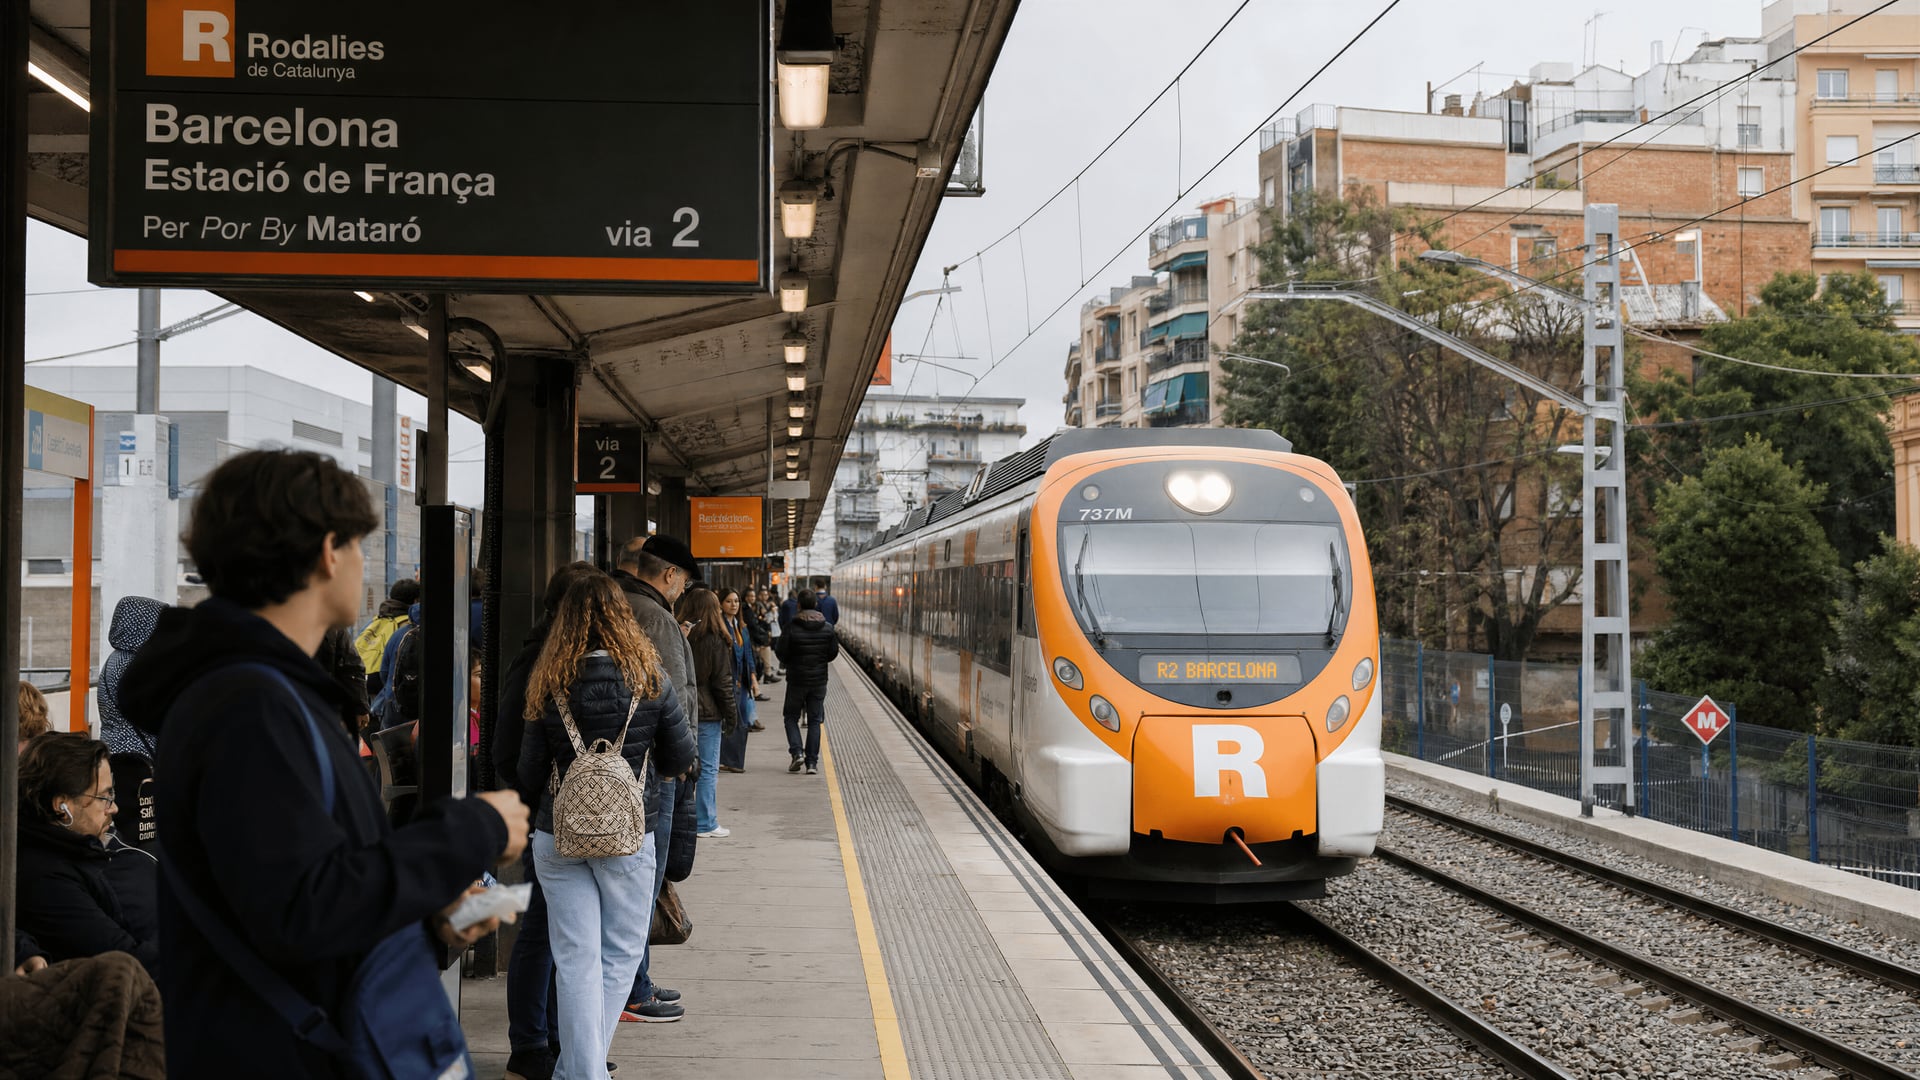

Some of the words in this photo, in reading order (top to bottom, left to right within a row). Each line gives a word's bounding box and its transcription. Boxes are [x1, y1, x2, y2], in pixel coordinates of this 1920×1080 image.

[182, 10, 231, 62] R
[248, 33, 385, 60] Rodalies
[247, 63, 268, 78] de
[273, 63, 355, 82] Catalunya
[146, 103, 398, 148] Barcelona
[146, 159, 290, 193] Estació
[303, 163, 351, 194] de
[364, 164, 495, 204] França
[143, 216, 189, 239] Per
[201, 216, 251, 240] Por
[260, 217, 296, 246] By
[307, 216, 422, 243] Mataró
[606, 220, 652, 247] via
[671, 207, 700, 247] 2
[595, 436, 620, 451] via
[599, 455, 616, 479] 2
[1079, 507, 1133, 521] 737M
[1157, 661, 1179, 679] R2
[1186, 661, 1277, 679] BARCELONA
[1697, 711, 1717, 729] M
[1192, 724, 1269, 798] R
